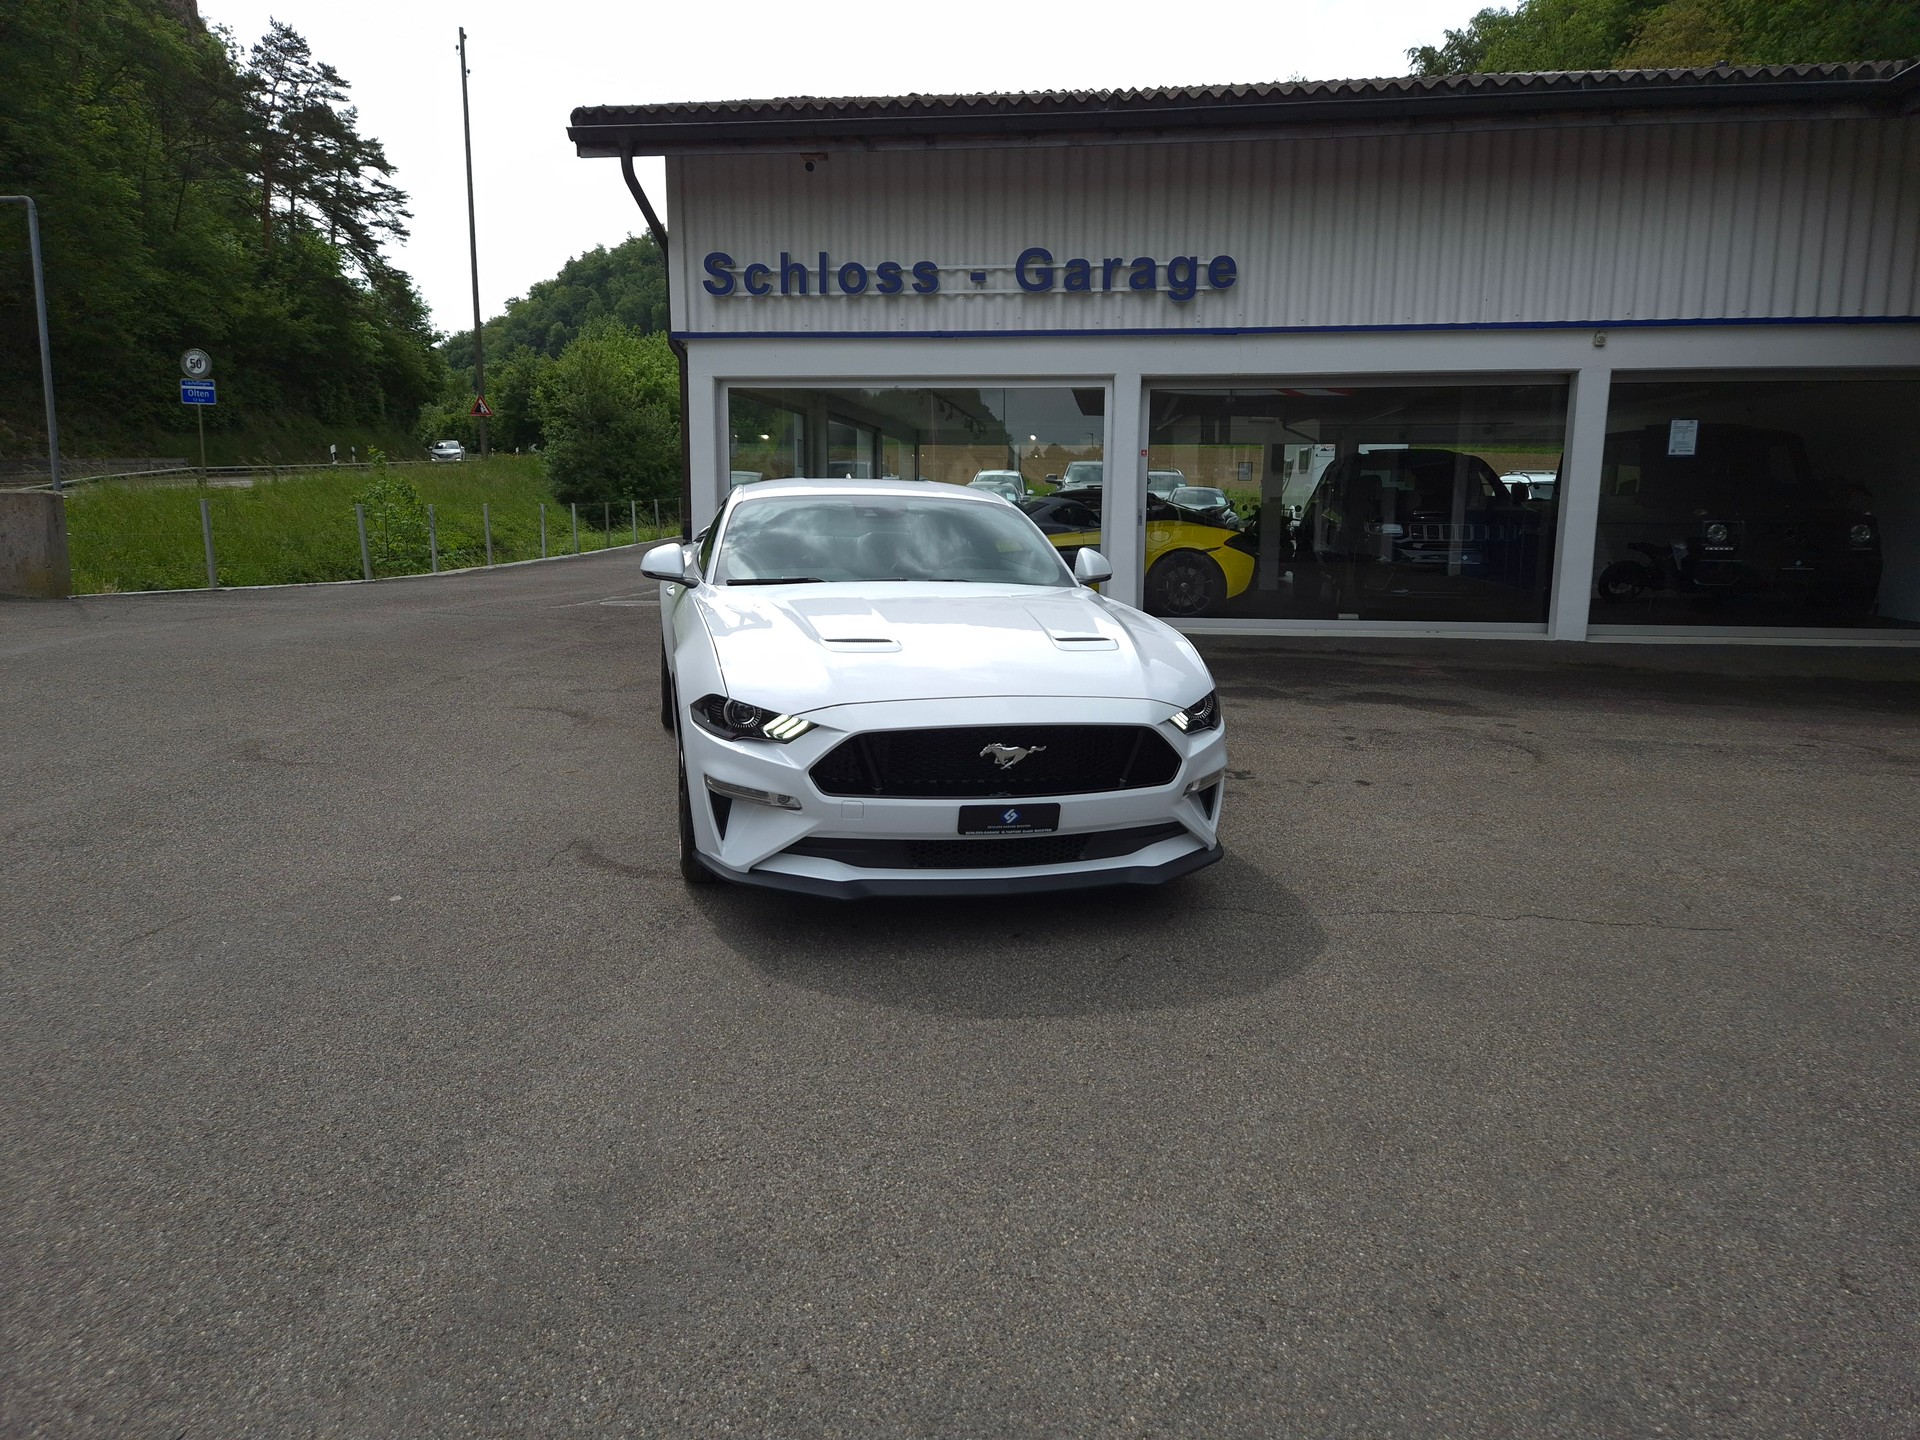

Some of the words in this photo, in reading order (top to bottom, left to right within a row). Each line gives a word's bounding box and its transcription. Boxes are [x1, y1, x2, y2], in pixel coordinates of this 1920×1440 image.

[703, 251, 940, 296] Schloss
[970, 272, 987, 283] -
[1015, 247, 1237, 302] Garage
[190, 359, 202, 369] 50
[187, 389, 210, 398] Olten
